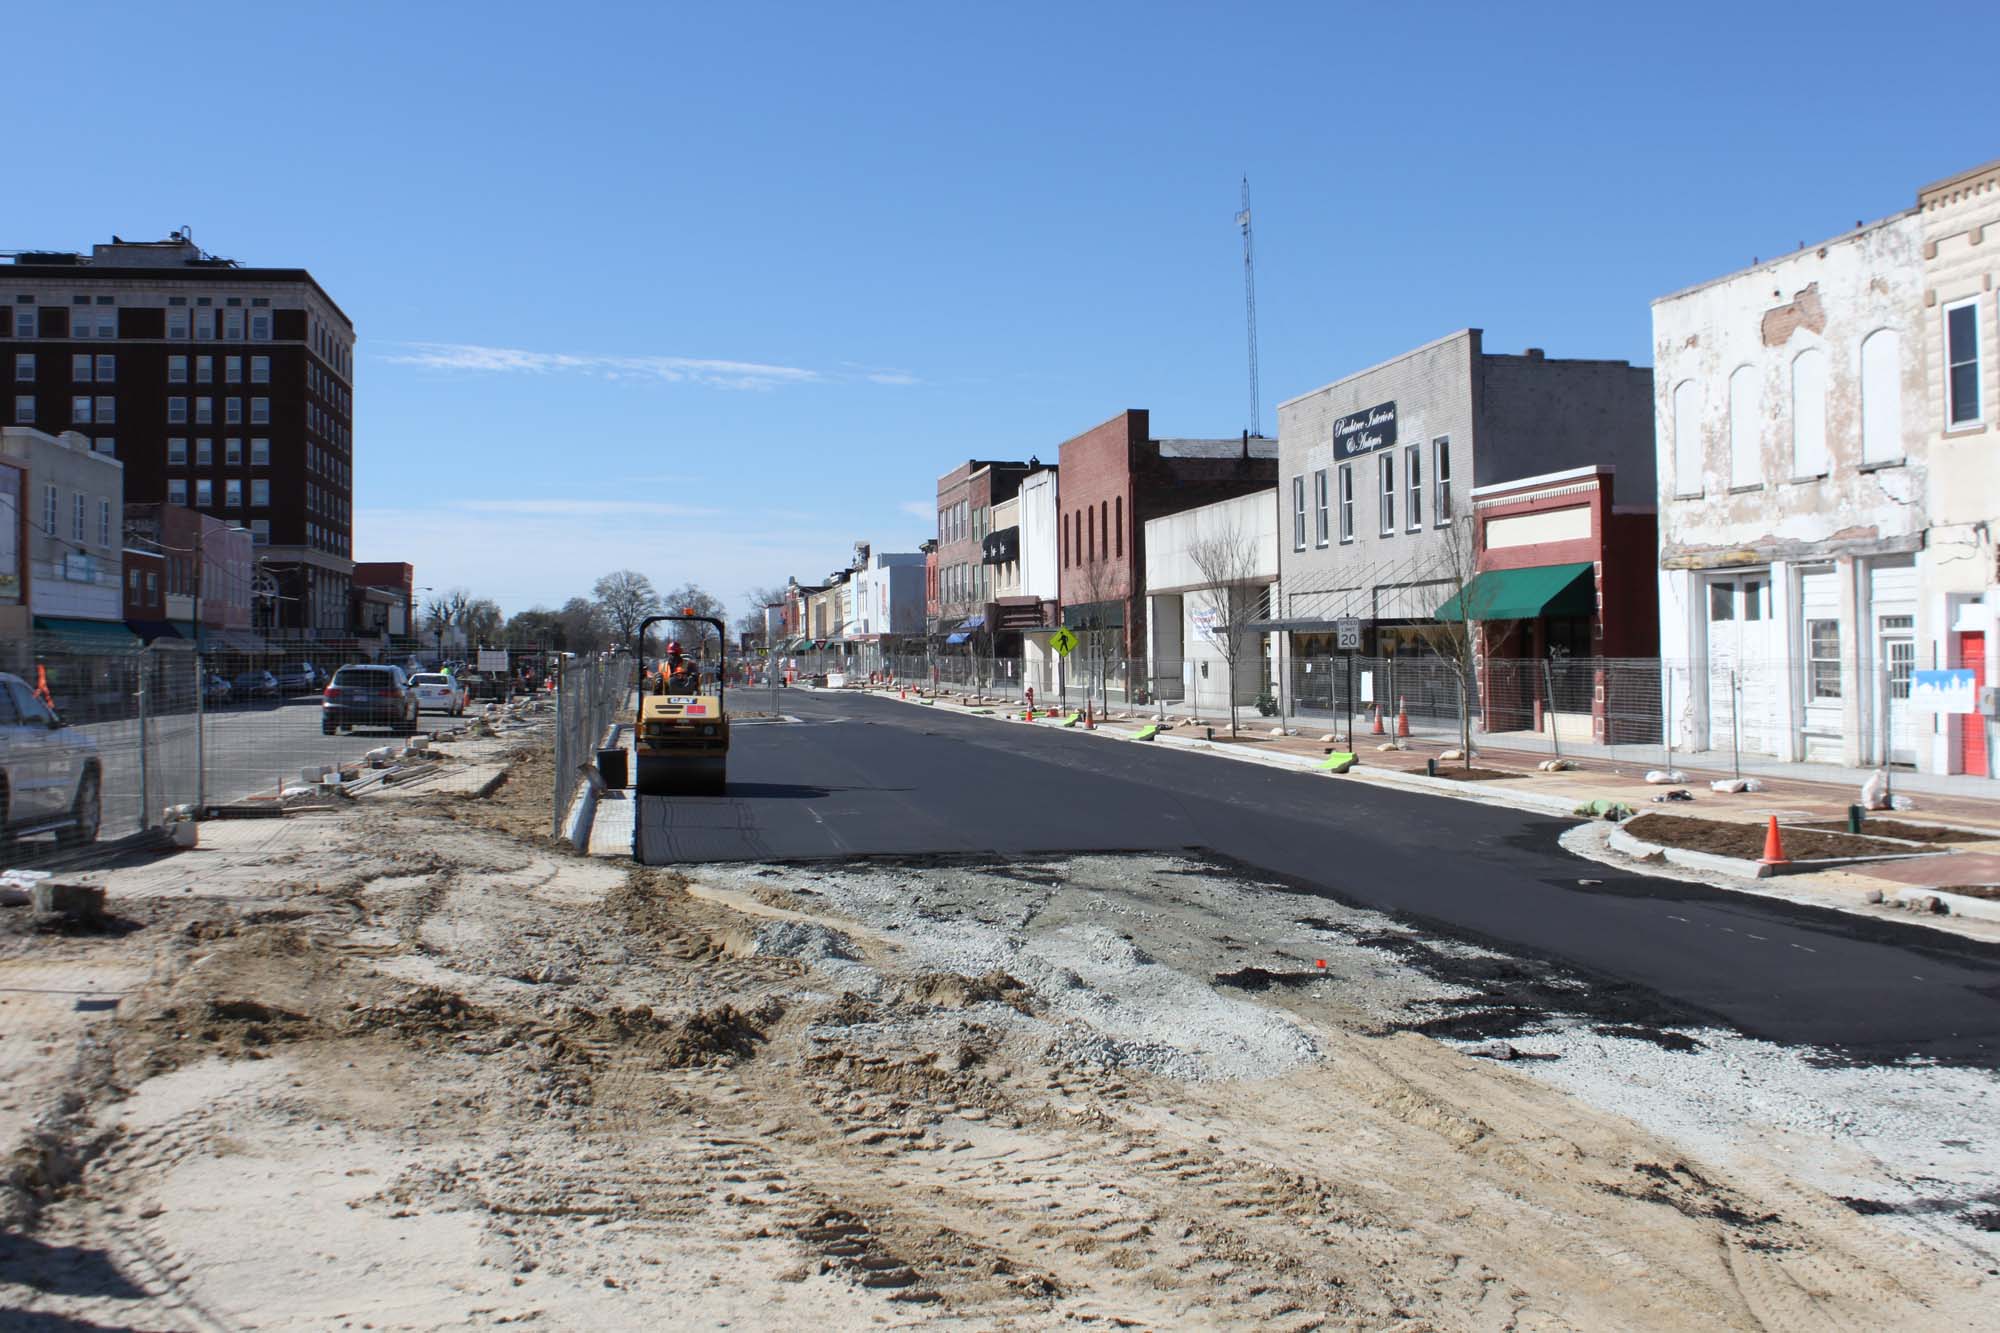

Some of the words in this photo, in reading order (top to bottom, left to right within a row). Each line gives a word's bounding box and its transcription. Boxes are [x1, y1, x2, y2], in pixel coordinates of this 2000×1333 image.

[1365, 408, 1394, 428] Interiors
[1346, 435, 1356, 454] &
[1341, 633, 1357, 646] 20
